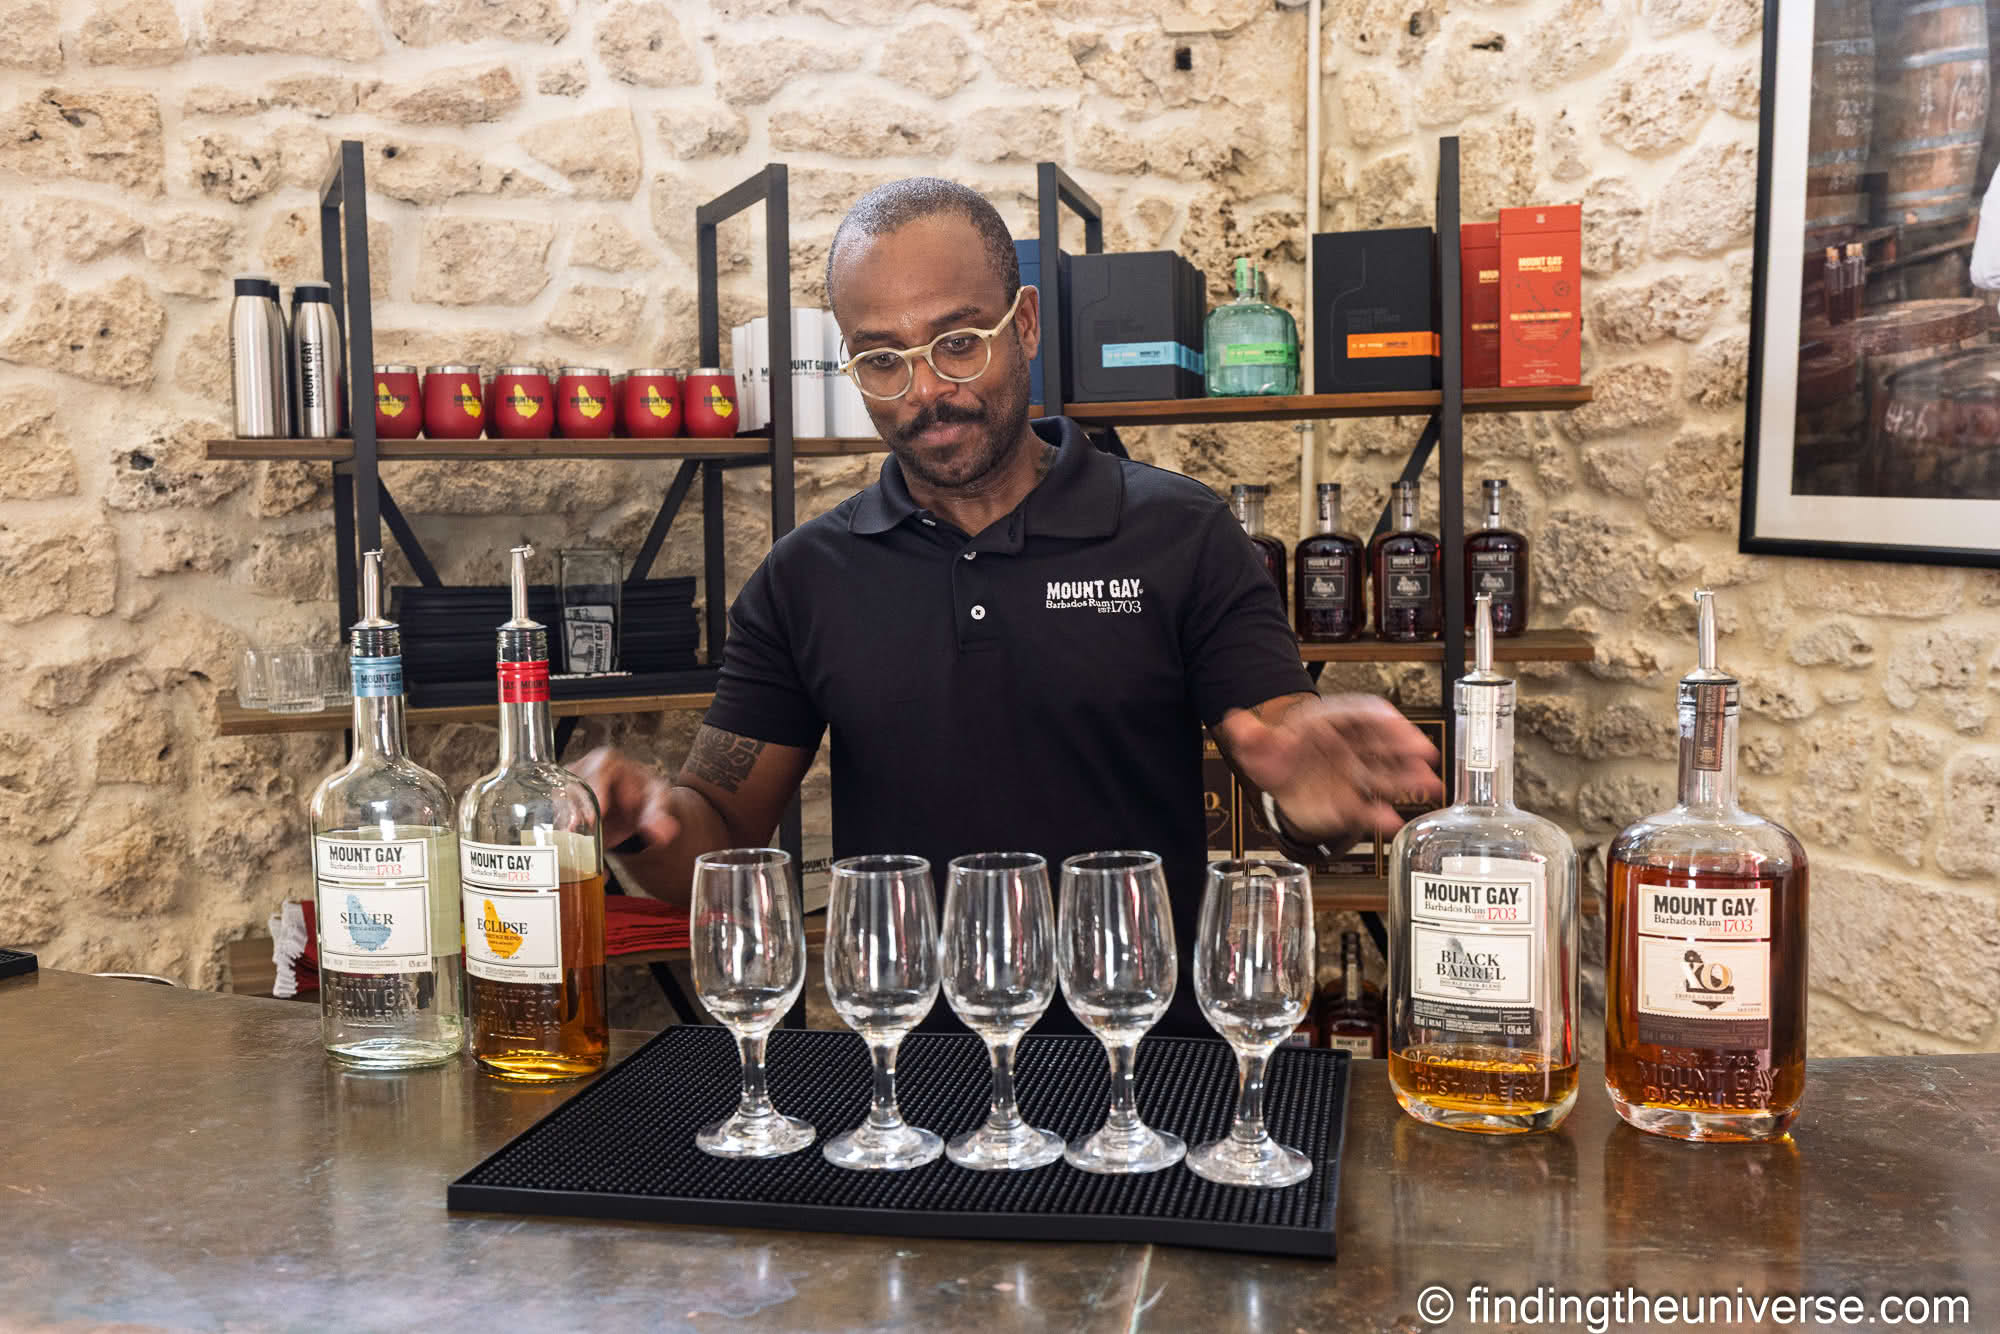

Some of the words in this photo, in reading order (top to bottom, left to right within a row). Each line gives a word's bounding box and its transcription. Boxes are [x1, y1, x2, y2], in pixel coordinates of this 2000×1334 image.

[301, 340, 313, 363] GAY
[303, 368, 314, 408] MOUNT
[1046, 580, 1105, 600] MOUNT
[1109, 579, 1141, 598] GAY
[1046, 600, 1088, 609] Barbados
[1088, 598, 1110, 607] Rum
[1111, 600, 1143, 614] 1703
[360, 674, 390, 684] MOUNT
[329, 845, 371, 862] MOUNT
[375, 847, 403, 862] GAY
[470, 851, 504, 869] MOUNT
[507, 855, 532, 870] GAY
[376, 864, 402, 875] 1703
[508, 872, 530, 880] 1703
[1425, 882, 1482, 904] MOUNT
[1486, 887, 1520, 905] GAY
[1424, 902, 1463, 913] Barbados
[1465, 904, 1486, 914] Rum
[1487, 907, 1517, 920] 1703
[1654, 895, 1718, 916] MOUNT
[1722, 898, 1756, 916] GAY
[340, 912, 394, 925] SILVER
[477, 918, 529, 935] ECLIPSE
[1654, 914, 1697, 926] Barbados
[1699, 917, 1721, 927] Rum
[1723, 919, 1753, 932] 1703
[1441, 950, 1499, 967] BLACK
[1436, 963, 1506, 981] BARREL
